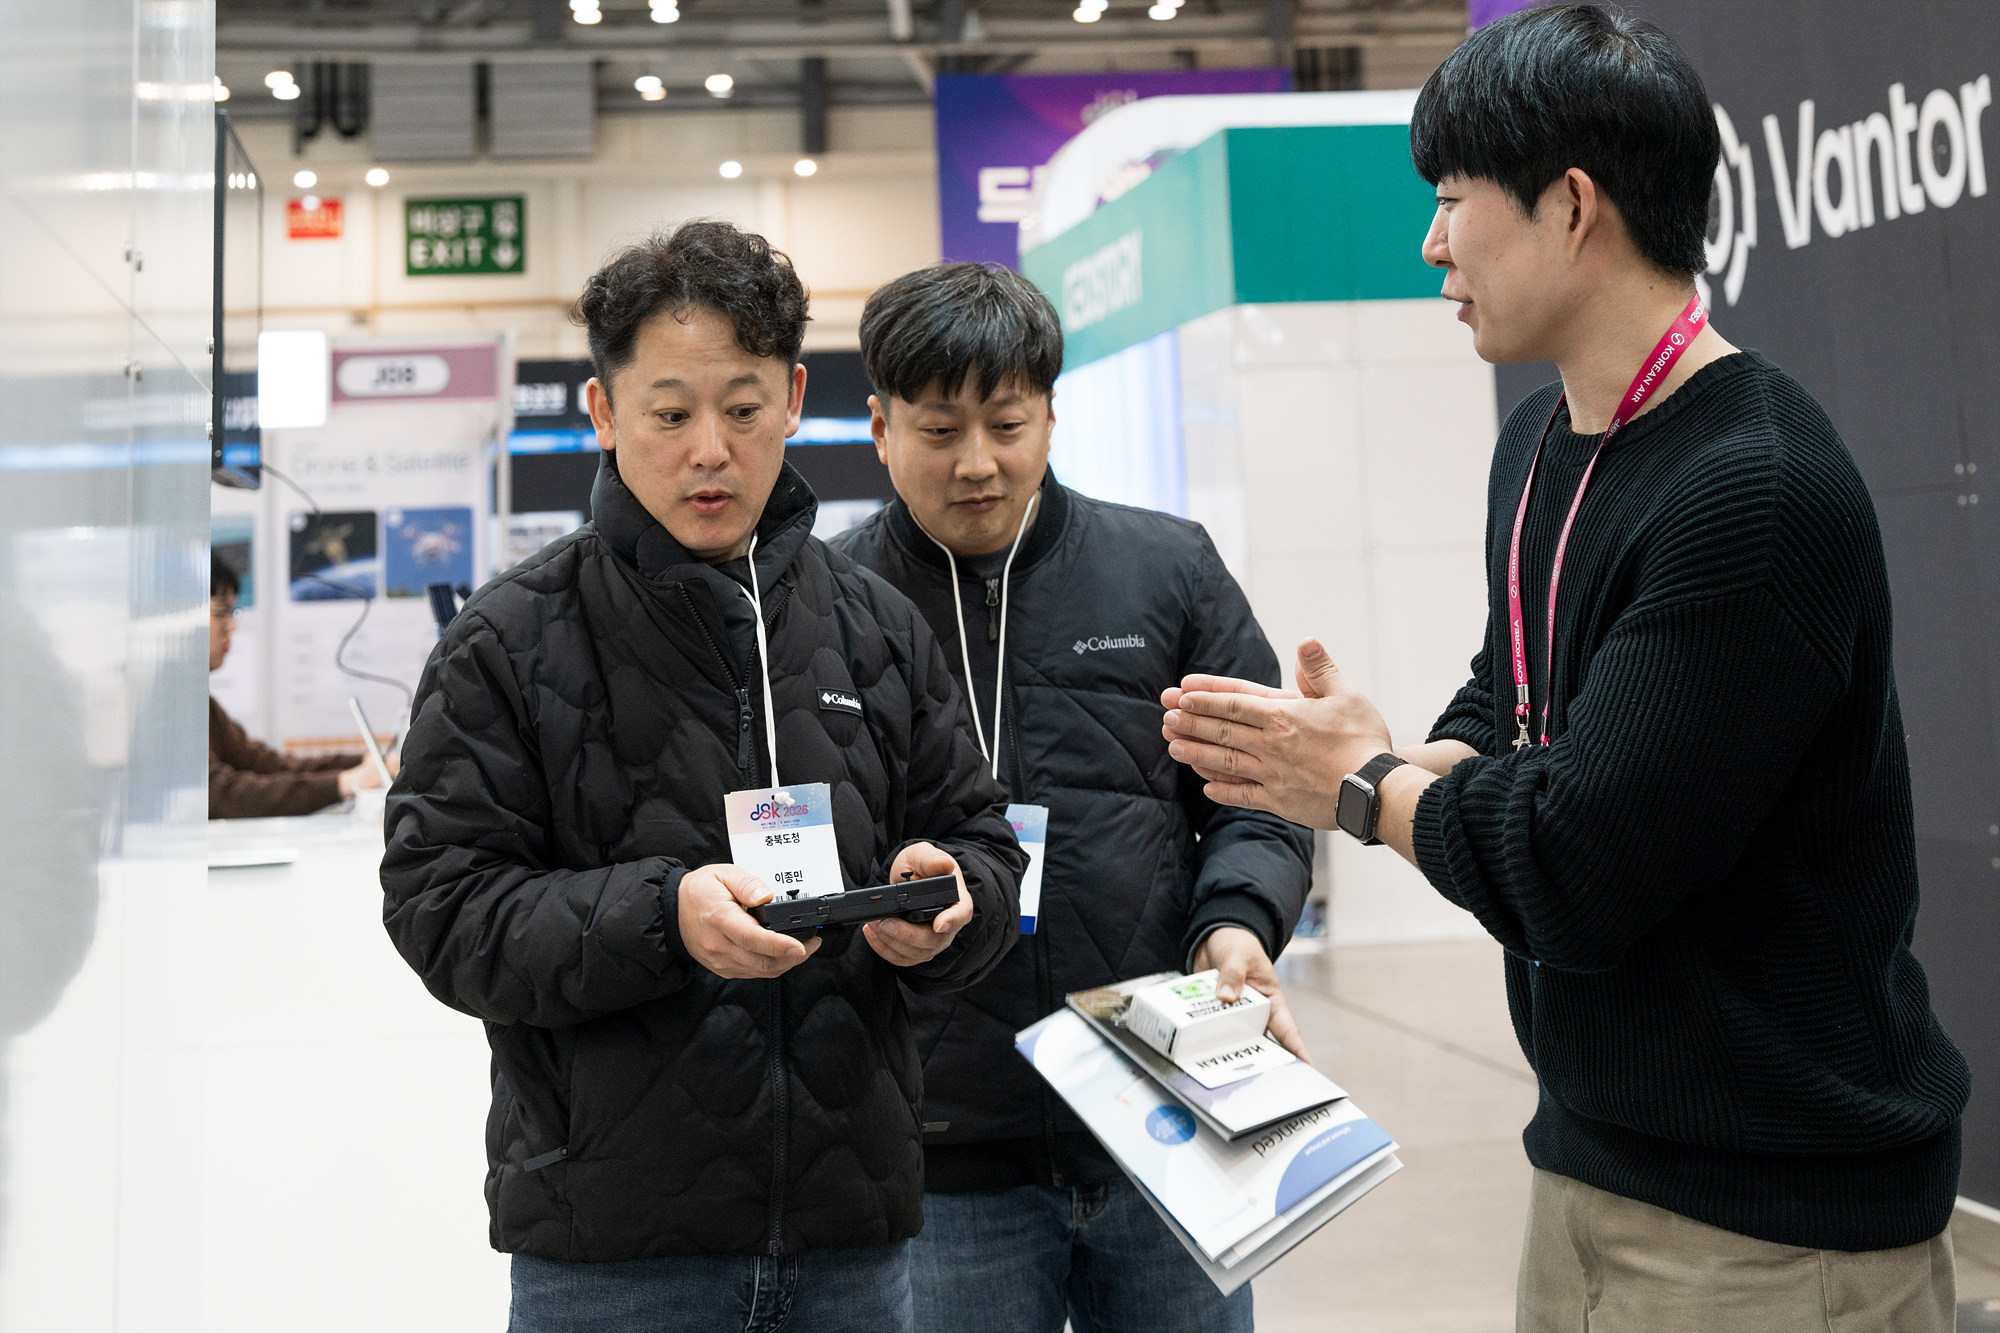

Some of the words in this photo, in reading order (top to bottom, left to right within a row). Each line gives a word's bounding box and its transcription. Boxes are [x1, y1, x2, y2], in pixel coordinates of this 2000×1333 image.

[1762, 73, 1992, 249] Vantor
[409, 236, 485, 269] EXIT
[1643, 344, 1675, 385] KOREAN
[1631, 384, 1646, 402] AIR
[1087, 633, 1146, 652] Columbia
[1513, 619, 1521, 658] KOREA
[831, 693, 862, 710] Columbia
[783, 804, 809, 818] 2026
[765, 832, 801, 847] 충북도청
[774, 869, 804, 885] 이종민
